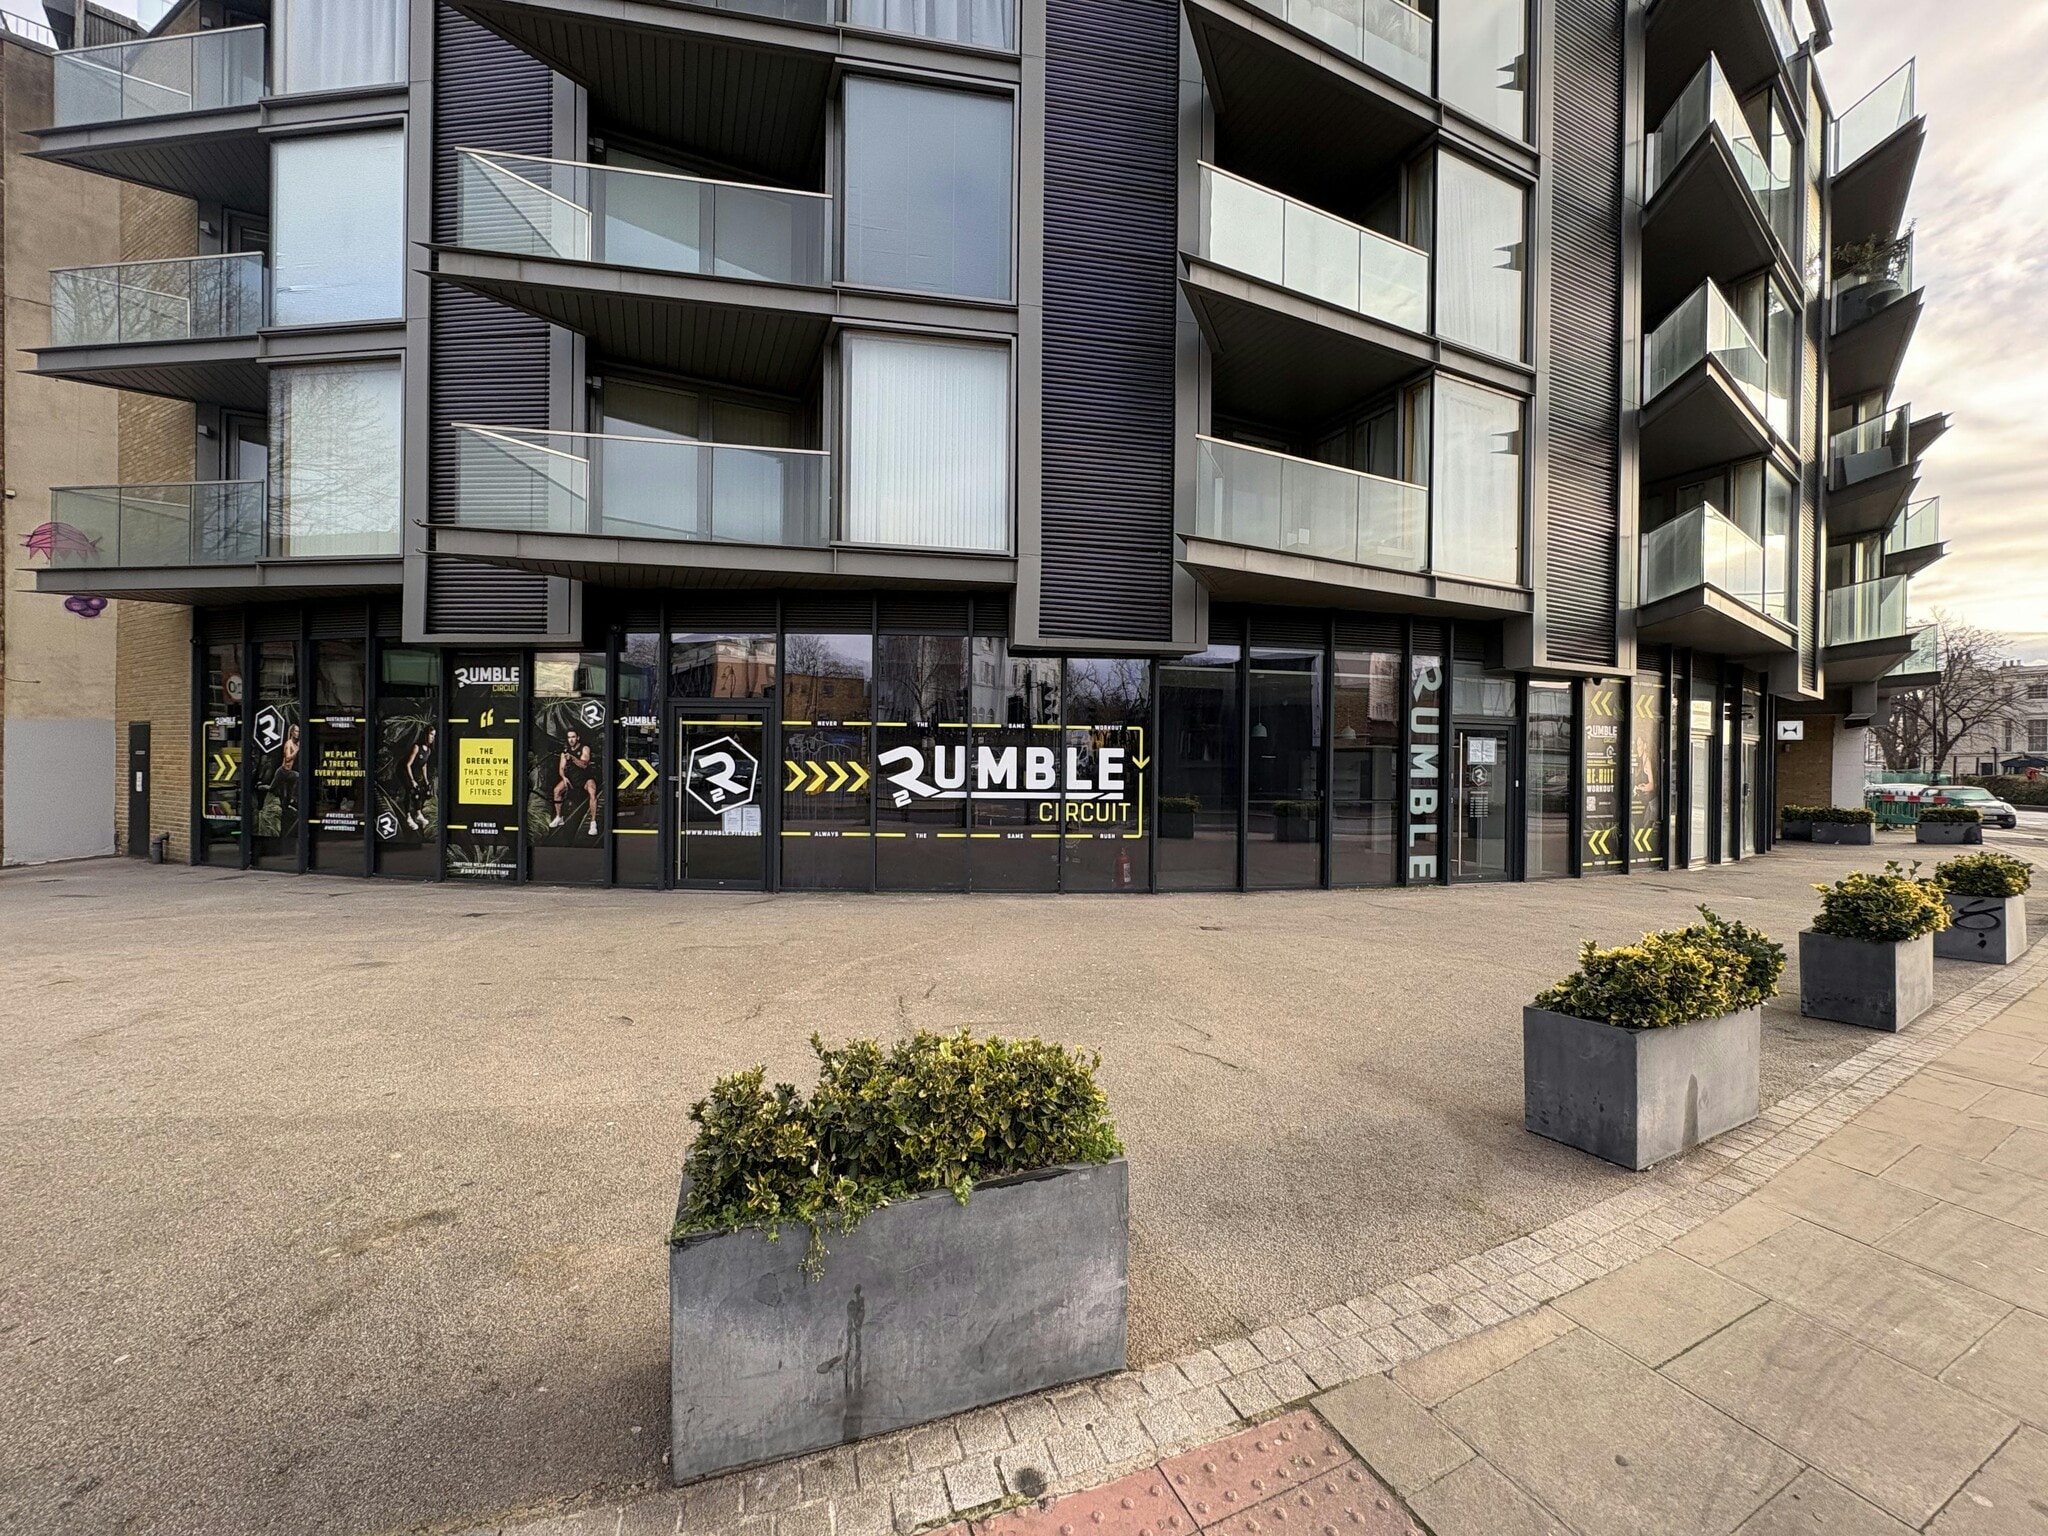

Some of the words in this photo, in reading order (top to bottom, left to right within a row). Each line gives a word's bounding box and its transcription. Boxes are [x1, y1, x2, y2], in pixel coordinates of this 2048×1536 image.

[454, 667, 519, 688] RUMBLE
[492, 684, 519, 692] CIRCUIT
[620, 716, 656, 727] RUMBLE
[1585, 725, 1617, 739] RUMBLE
[464, 768, 490, 776] THAT'S
[878, 746, 1125, 799] RUMBLE
[1409, 660, 1442, 879] RUMBLE
[465, 778, 494, 786] FUTURE
[469, 788, 502, 796] FITNESS
[1586, 785, 1614, 793] WORKOUT
[1039, 802, 1131, 822] CIRCUIT
